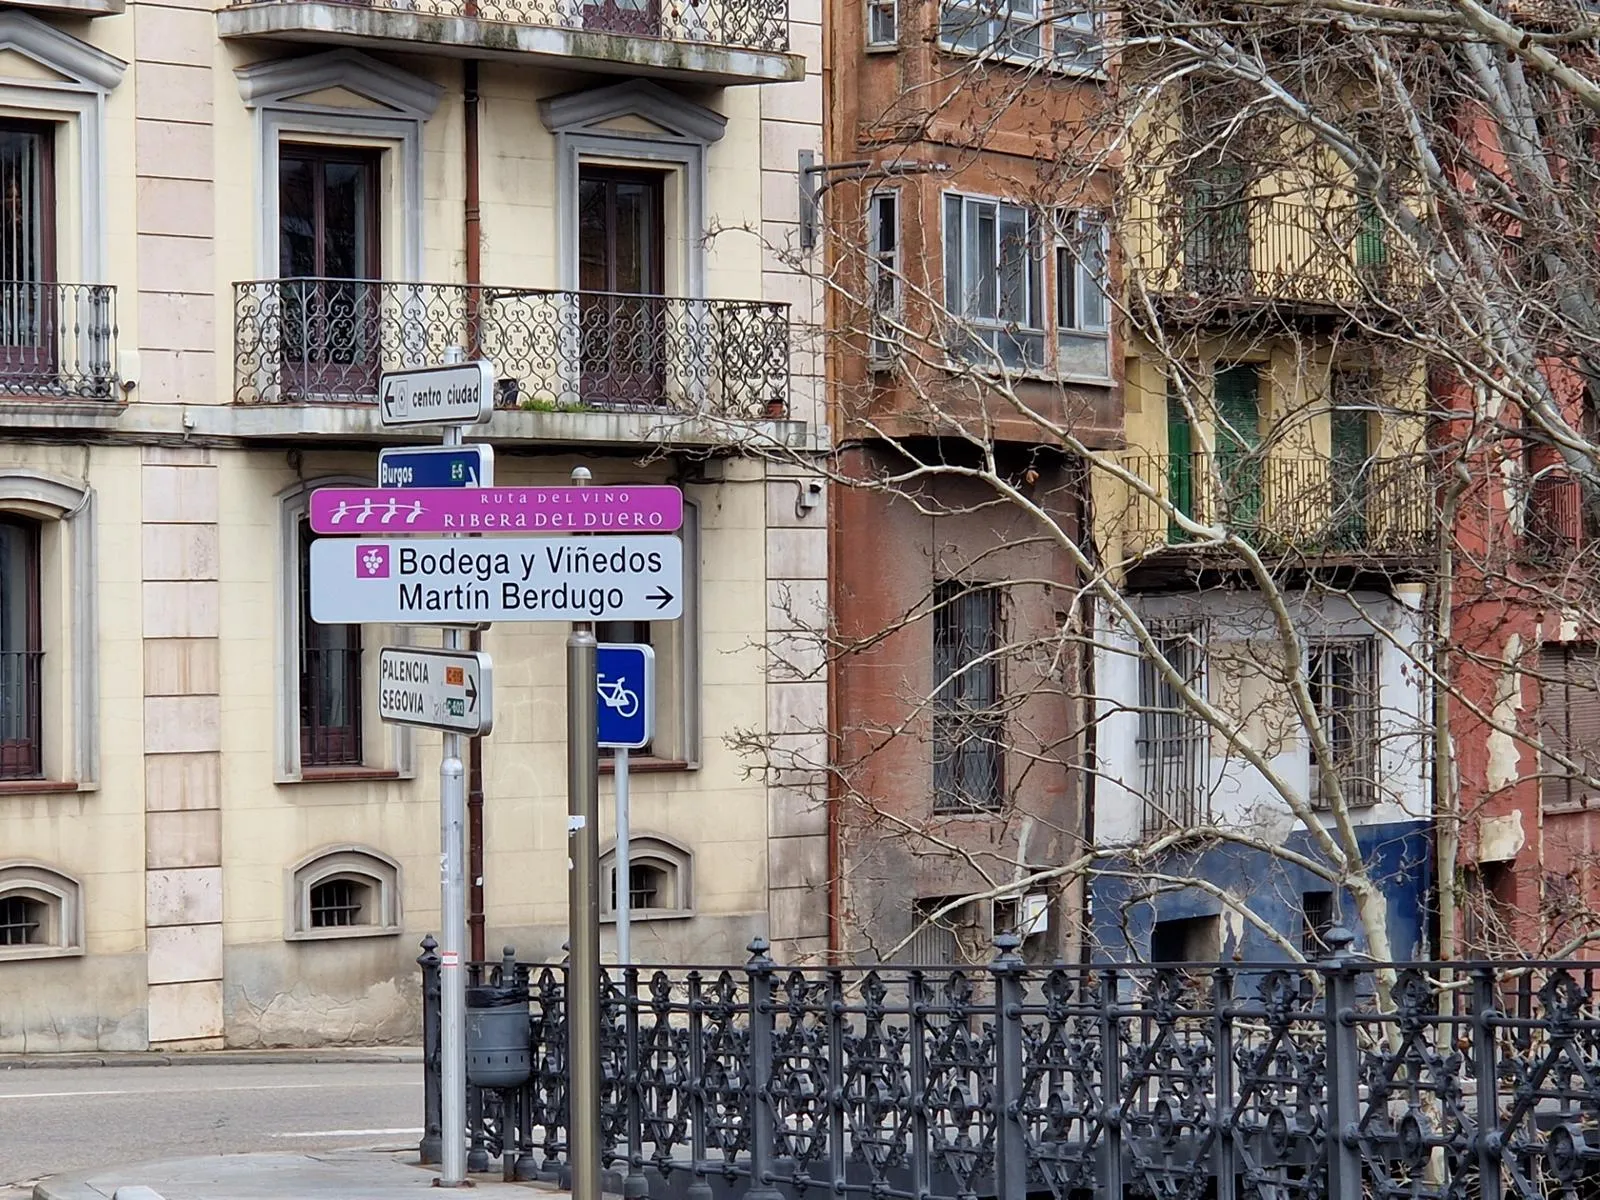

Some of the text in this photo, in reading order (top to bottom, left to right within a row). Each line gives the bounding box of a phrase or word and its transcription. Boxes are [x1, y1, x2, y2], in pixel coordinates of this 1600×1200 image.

[412, 383, 479, 408] centro ciudad
[382, 463, 413, 487] Burgos
[451, 463, 463, 479] E-5
[399, 546, 662, 581] Bodega y Viñedos
[399, 582, 624, 615] Martín Berdugo
[382, 659, 429, 684] PALENCIA
[382, 689, 424, 714] SEGOVIA
